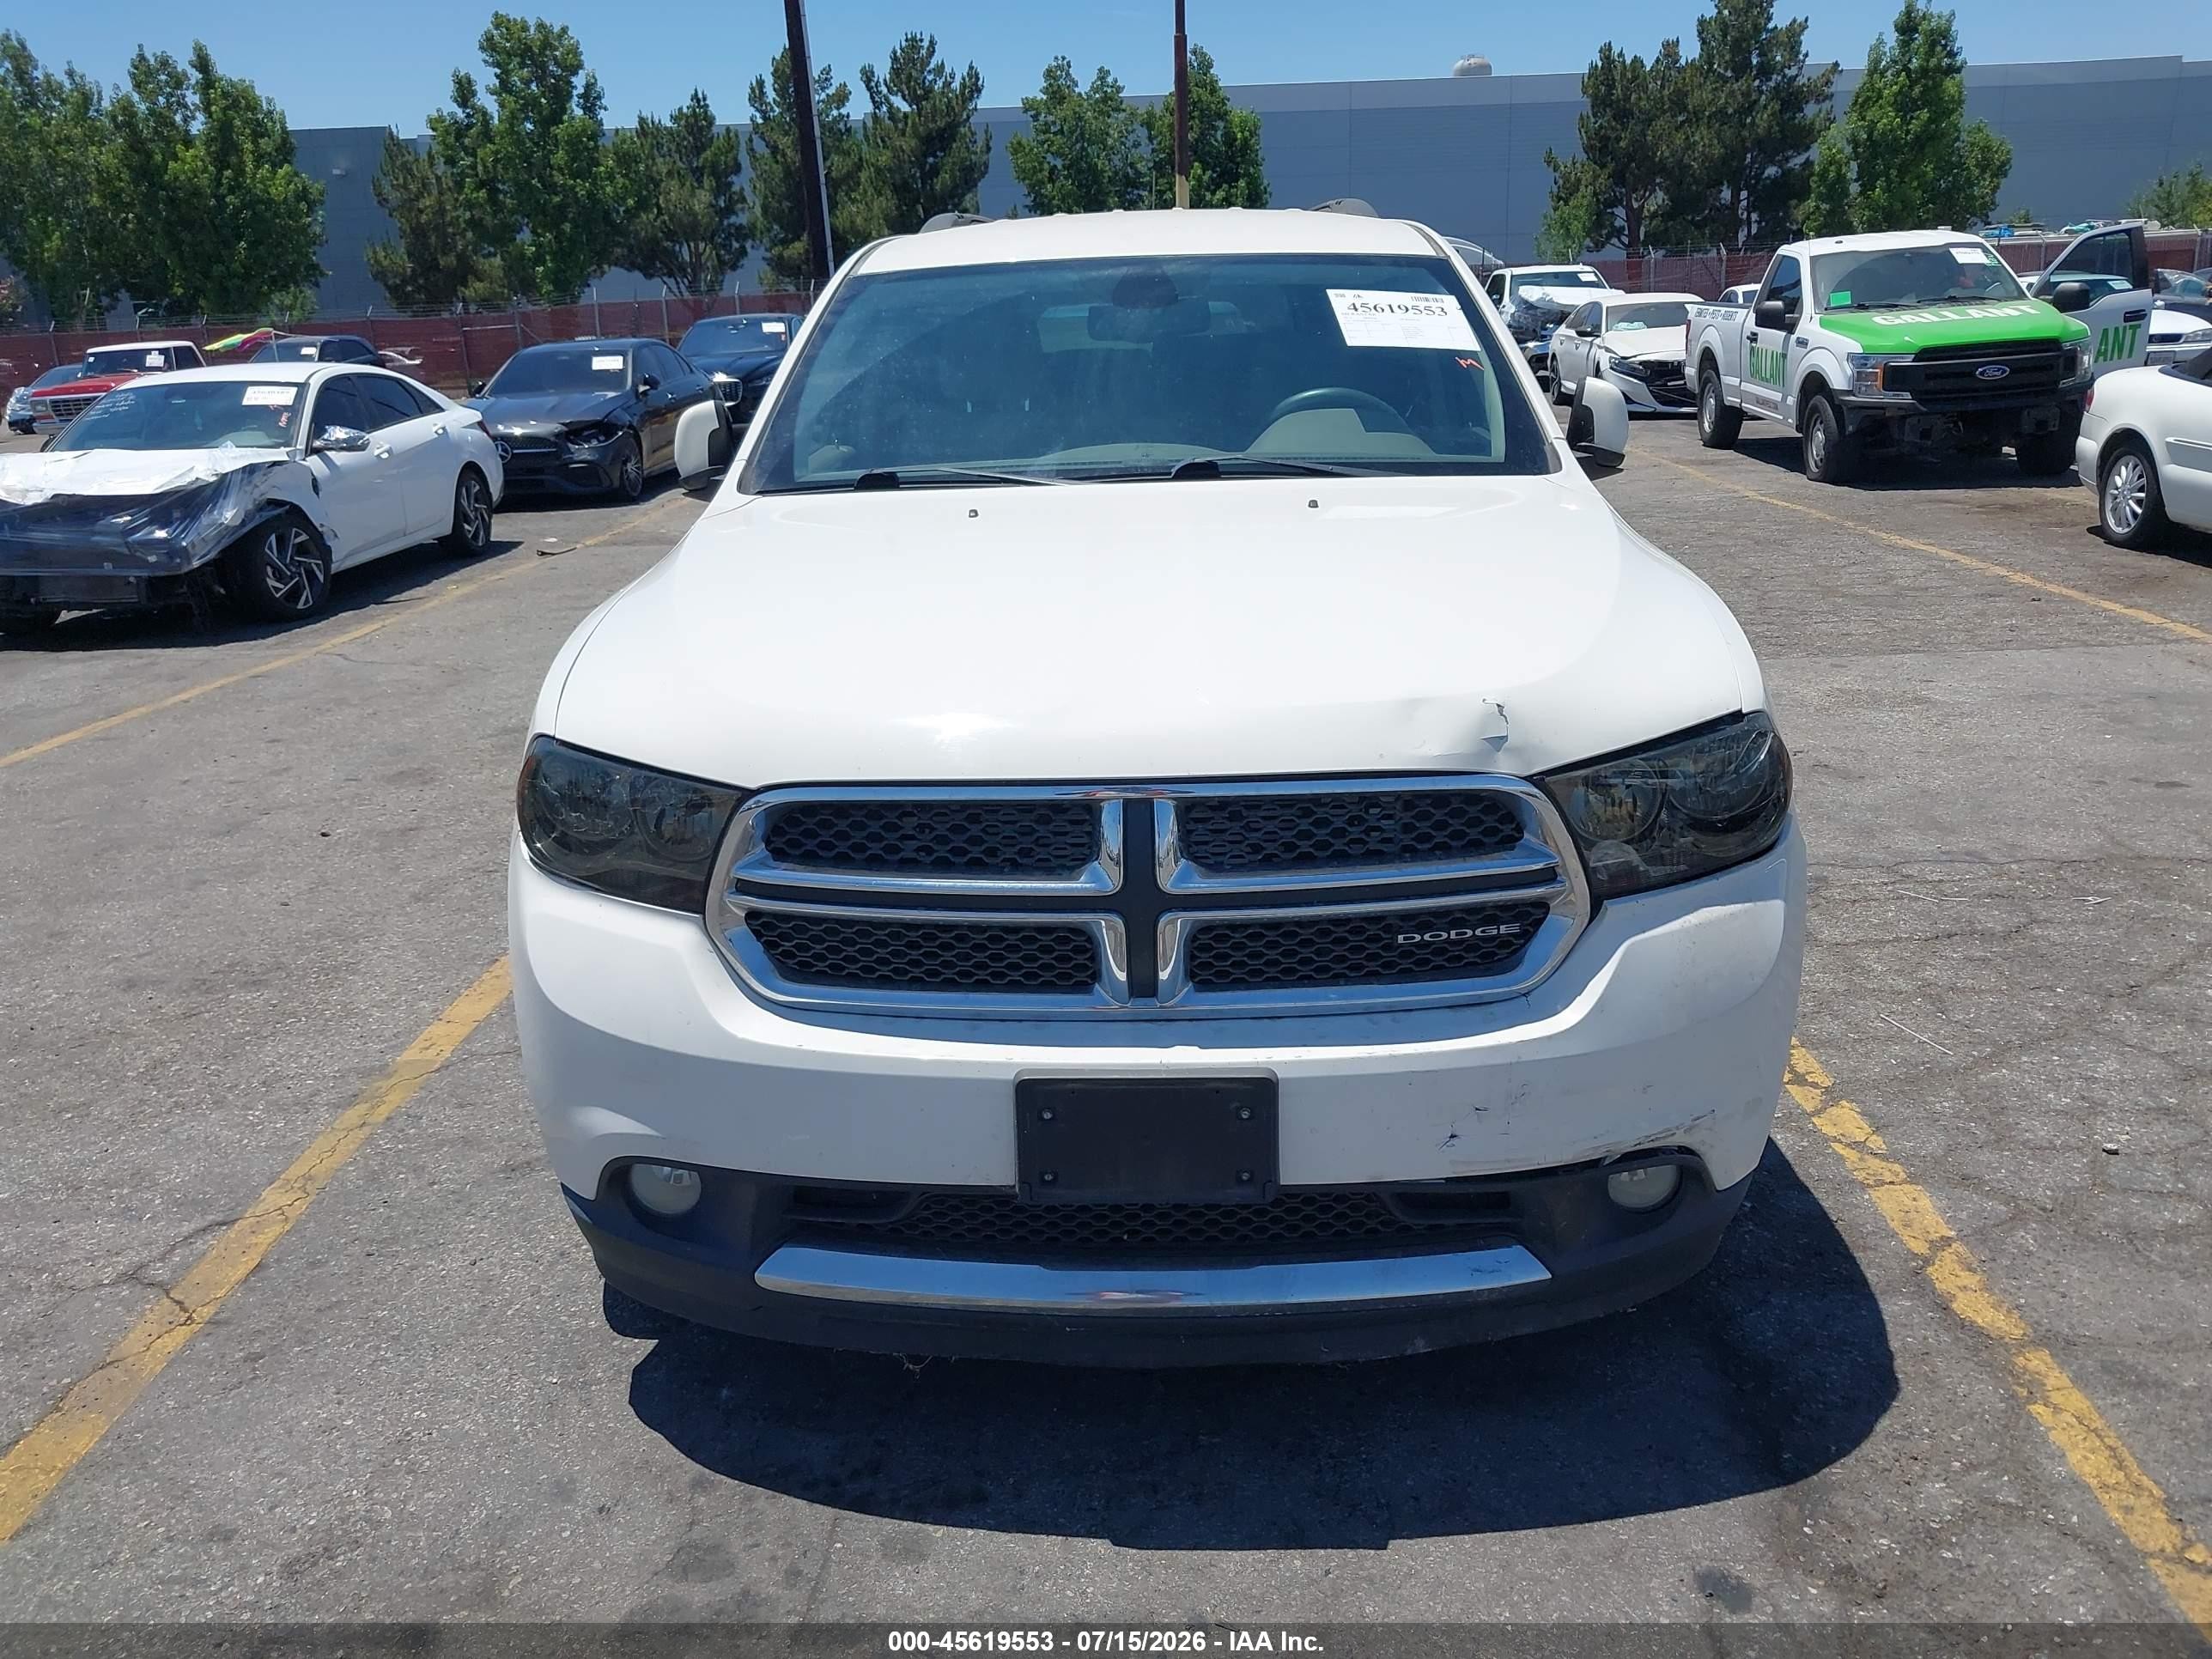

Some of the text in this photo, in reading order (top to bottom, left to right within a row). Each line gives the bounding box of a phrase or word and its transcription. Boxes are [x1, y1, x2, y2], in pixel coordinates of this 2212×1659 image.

[1346, 301, 1448, 317] 45619553
[1870, 305, 2041, 325] GALLANT
[2094, 323, 2142, 364] ANT
[1749, 345, 1787, 388] GALLANT
[1397, 923, 1522, 944] DODGE
